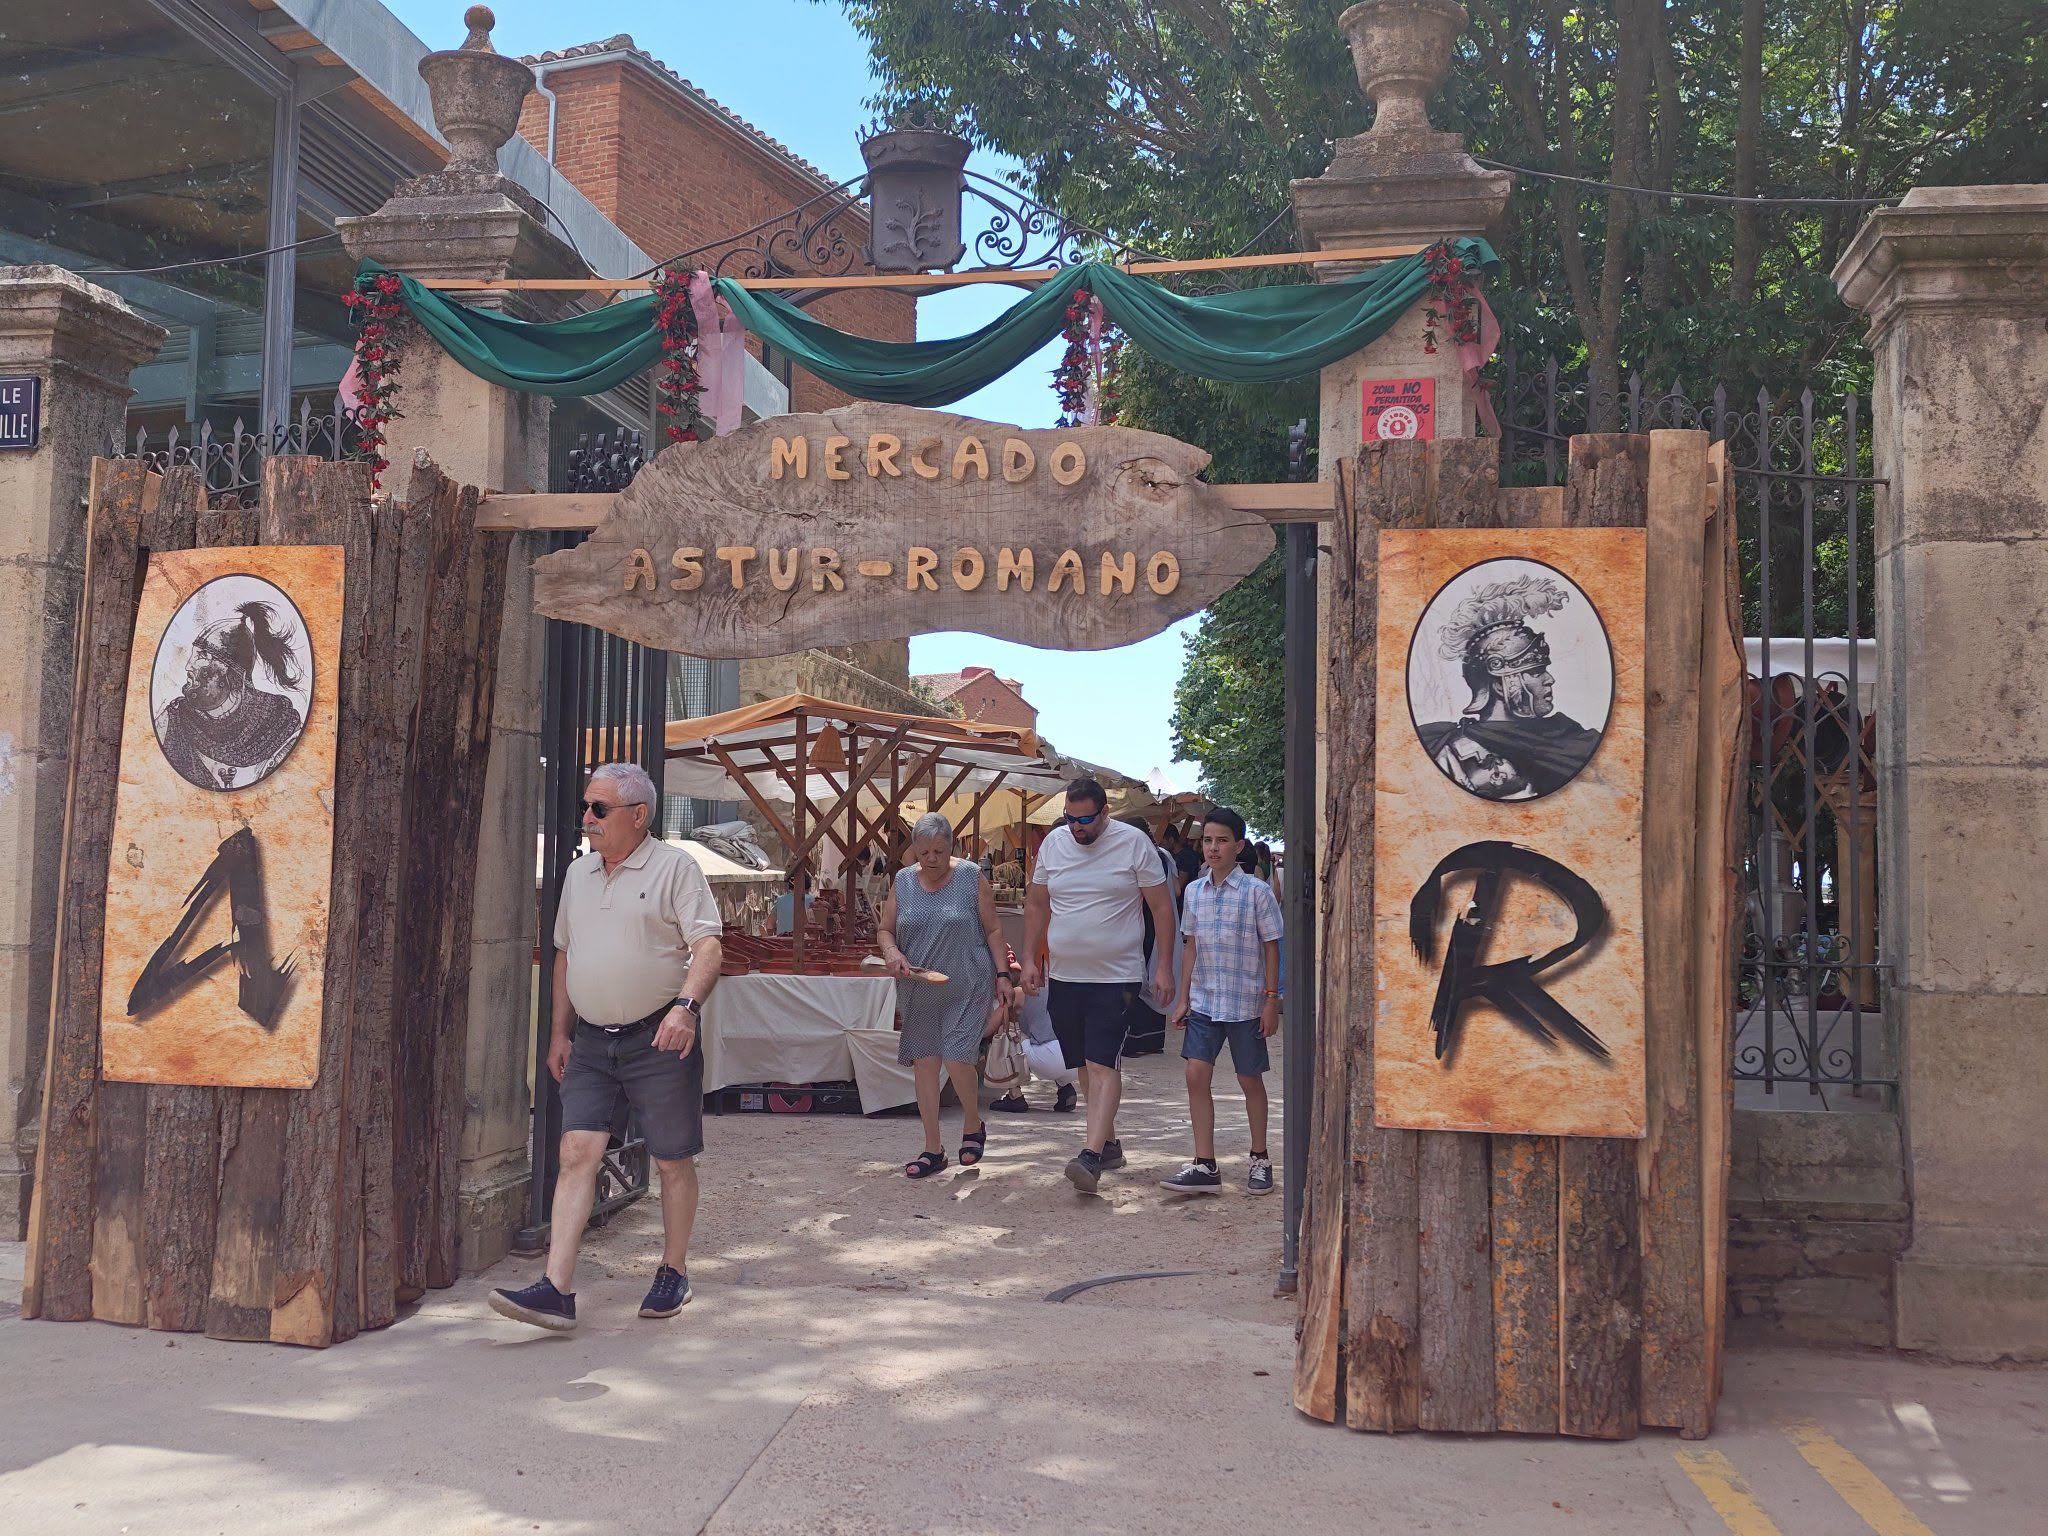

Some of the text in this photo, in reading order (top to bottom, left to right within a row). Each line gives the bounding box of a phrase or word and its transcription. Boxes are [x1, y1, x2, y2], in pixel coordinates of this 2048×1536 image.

[1373, 382, 1421, 395] ZONA NO
[1375, 395, 1422, 404] PERMITIDA
[771, 433, 1087, 486] MERCADO
[623, 546, 1181, 596] ASTUR-ROMANO
[127, 826, 299, 1033] A
[1409, 840, 1612, 1060] R
